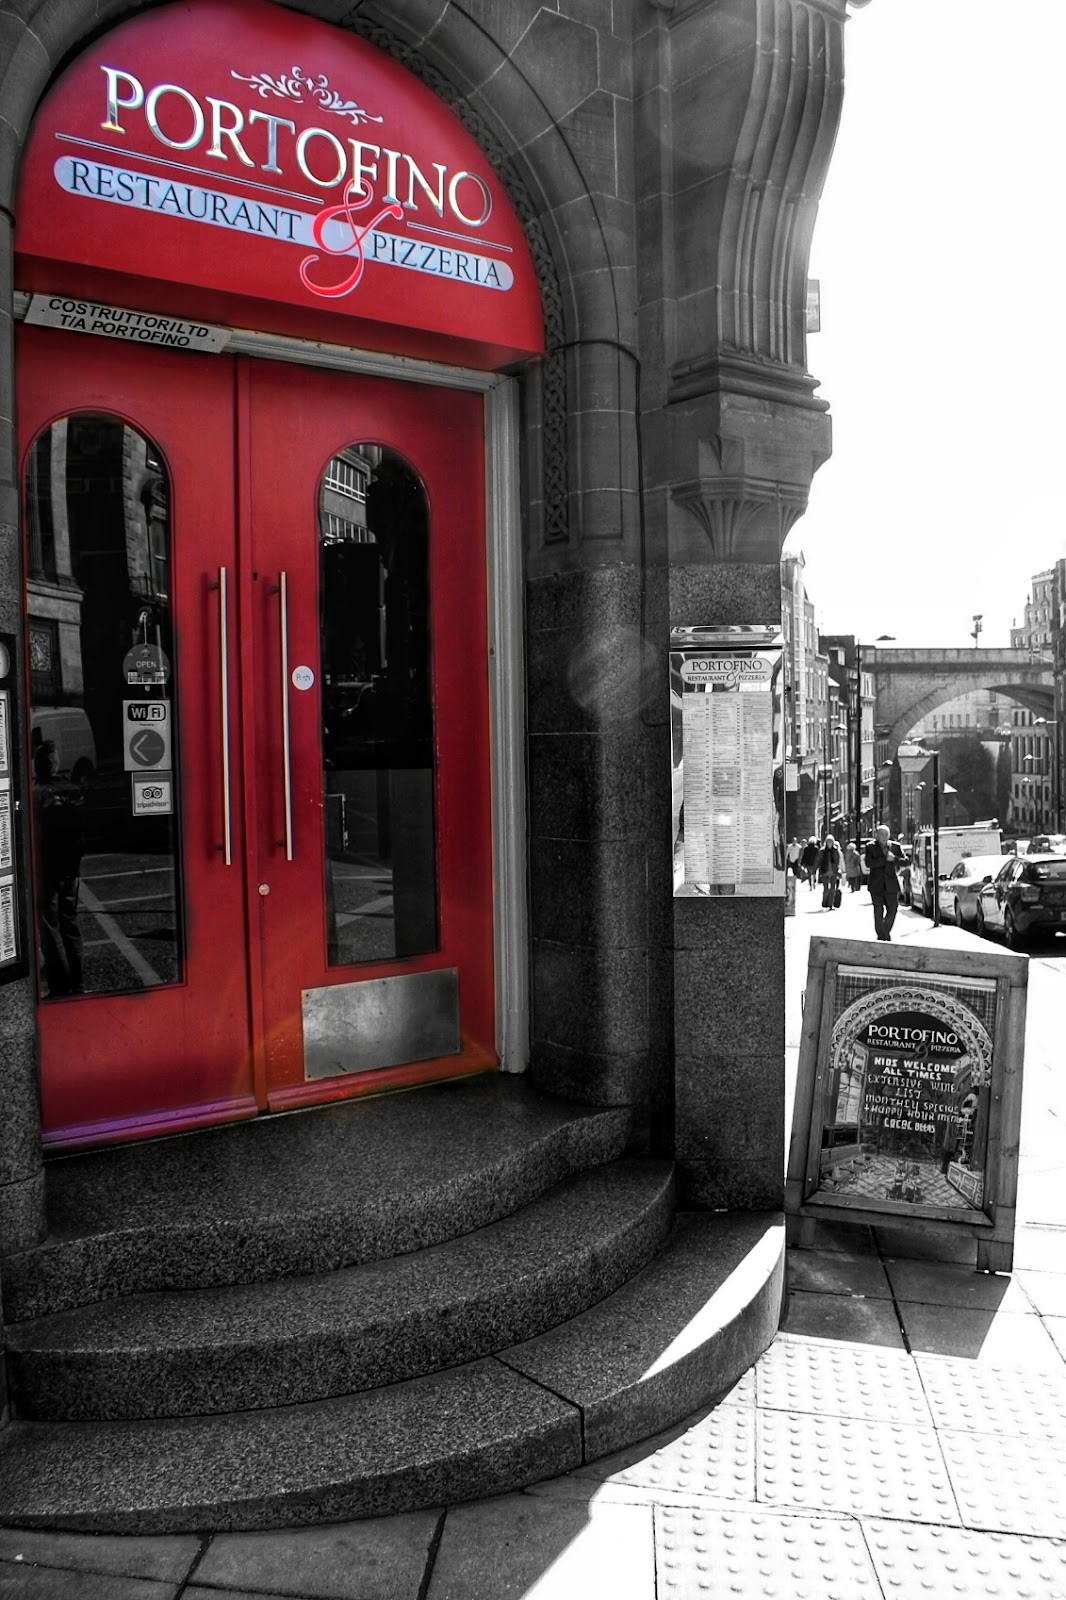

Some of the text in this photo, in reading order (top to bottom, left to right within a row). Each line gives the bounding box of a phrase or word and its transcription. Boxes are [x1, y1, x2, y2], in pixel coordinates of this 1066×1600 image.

[100, 65, 493, 228] PORTOFINO
[69, 159, 503, 298] RESTAURANT & PIZZERIA
[60, 313, 190, 347] T/A PORTOFINO
[135, 660, 157, 668] OPEN
[692, 660, 763, 672] PORTOFINO
[868, 1024, 958, 1044] PORTOFINO
[867, 1038, 917, 1049] RESTAURANT
[930, 1044, 962, 1053] PIZZERIA
[874, 1057, 957, 1073] KIDS WELCOME
[883, 1067, 942, 1080] ALL TIMES
[868, 1074, 956, 1093] EXTENSIVE WINE
[895, 1087, 922, 1099] LIST
[865, 1094, 919, 1112] MONTHLY
[907, 1110, 934, 1120] HOUR
[884, 1117, 913, 1130] LOCAL
